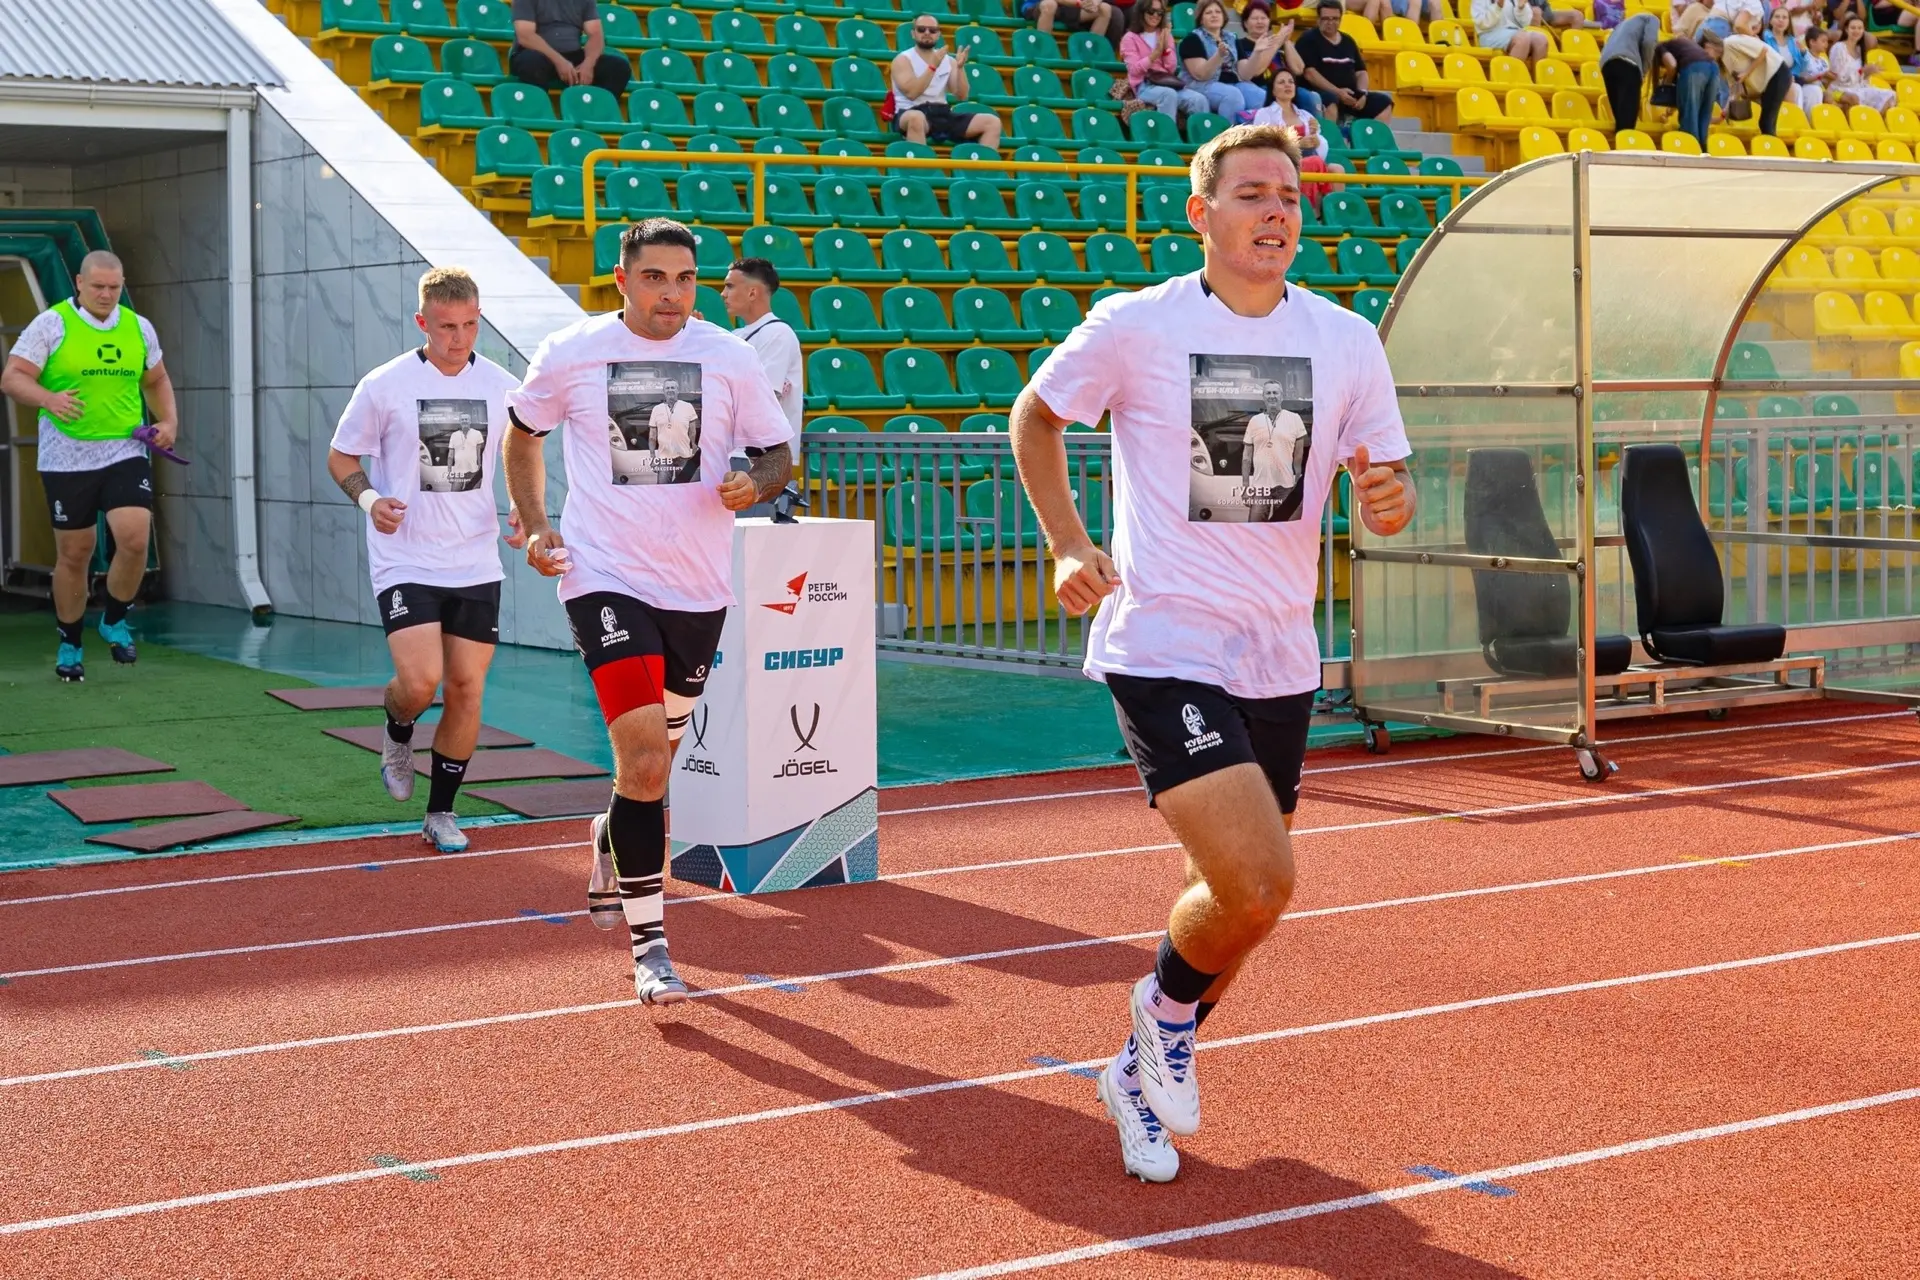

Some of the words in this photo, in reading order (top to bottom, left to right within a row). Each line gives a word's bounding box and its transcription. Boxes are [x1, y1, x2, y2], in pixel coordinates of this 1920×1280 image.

[81, 367, 136, 377] centurion
[641, 457, 673, 467] ГУСЕВ
[1231, 485, 1272, 498] ГУСЕВ
[807, 582, 839, 593] РЕГБИ
[807, 592, 848, 603] РОССИИ
[601, 629, 628, 642] КУБАНЬ
[764, 647, 844, 671] СИБУР
[1185, 731, 1221, 748] КУБАНЬ
[681, 754, 721, 777] JÖGEL
[772, 759, 839, 778] JÖGEL
